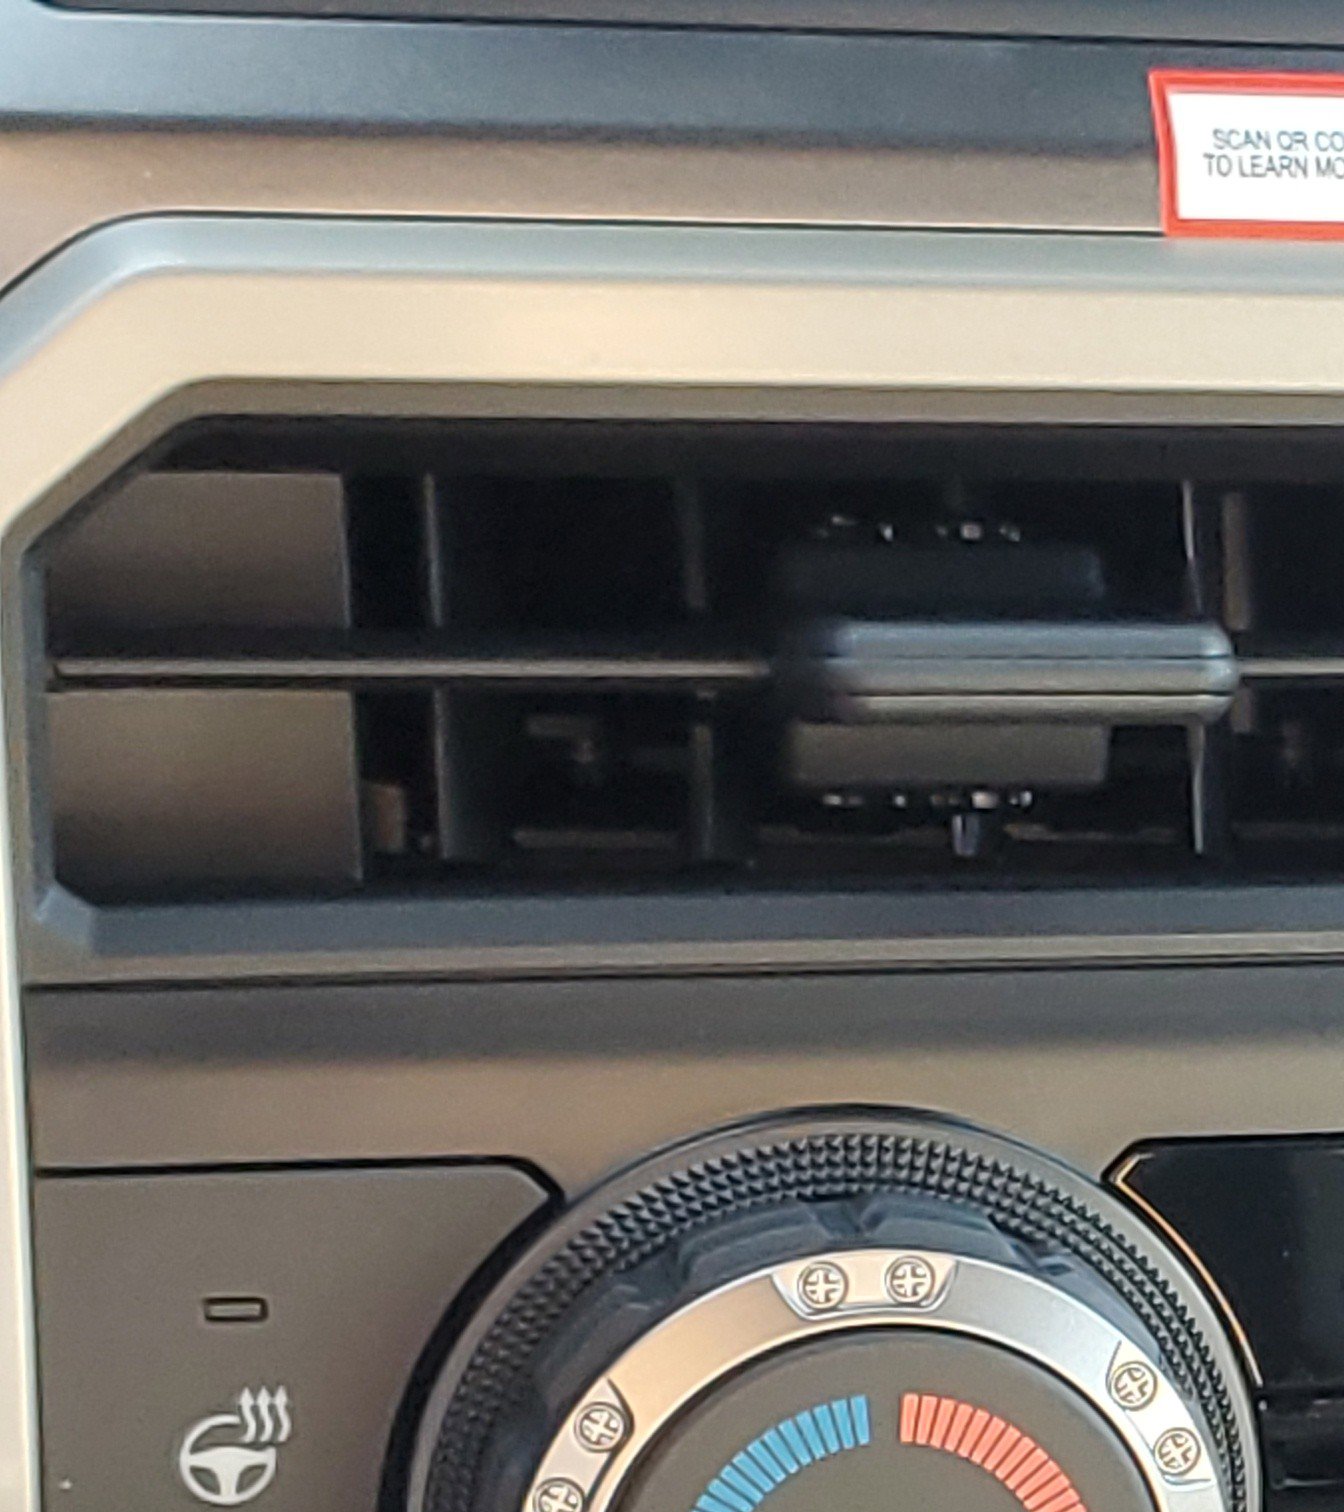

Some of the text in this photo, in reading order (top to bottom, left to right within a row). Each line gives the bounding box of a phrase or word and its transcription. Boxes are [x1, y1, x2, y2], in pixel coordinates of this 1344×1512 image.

[1212, 128, 1271, 150] SCAN
[1203, 152, 1233, 177] TO
[1238, 154, 1308, 179] LEARN
